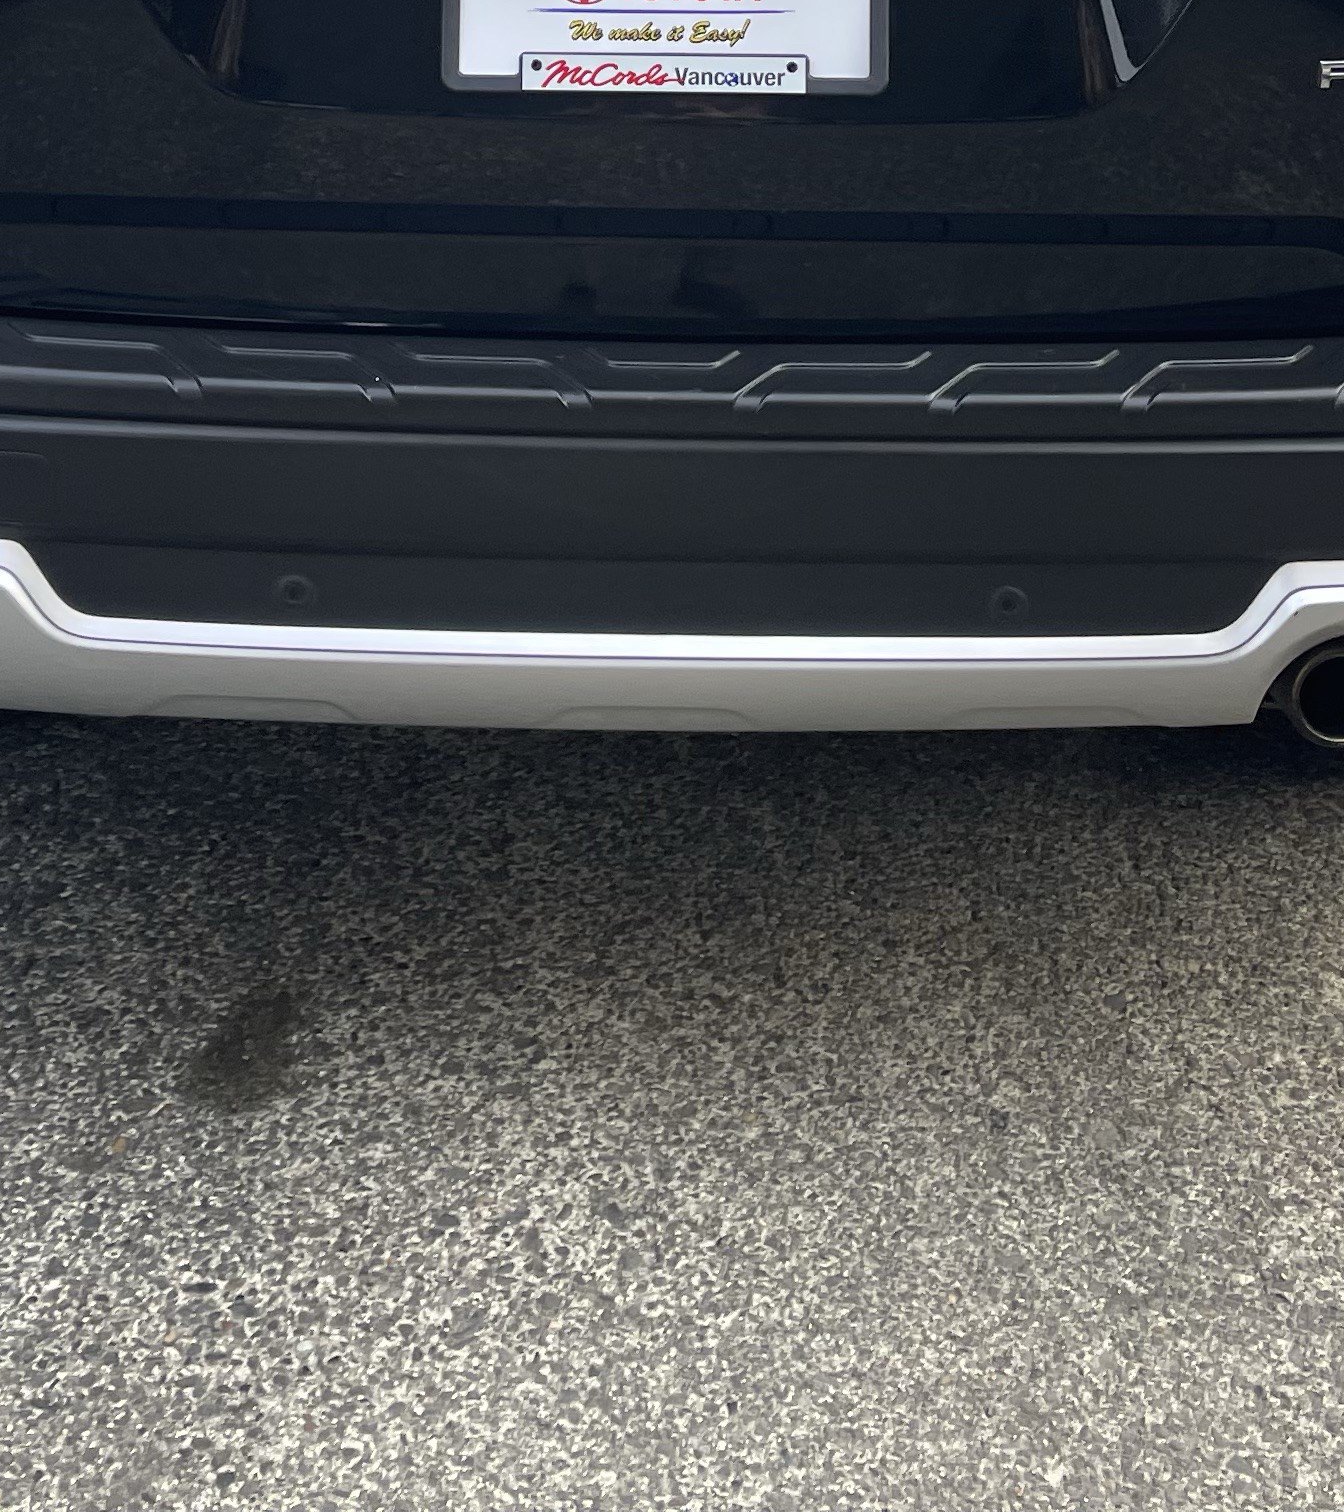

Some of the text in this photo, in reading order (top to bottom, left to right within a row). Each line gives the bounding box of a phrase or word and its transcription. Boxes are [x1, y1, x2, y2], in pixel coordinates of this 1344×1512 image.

[568, 18, 751, 47] We make it Easy!
